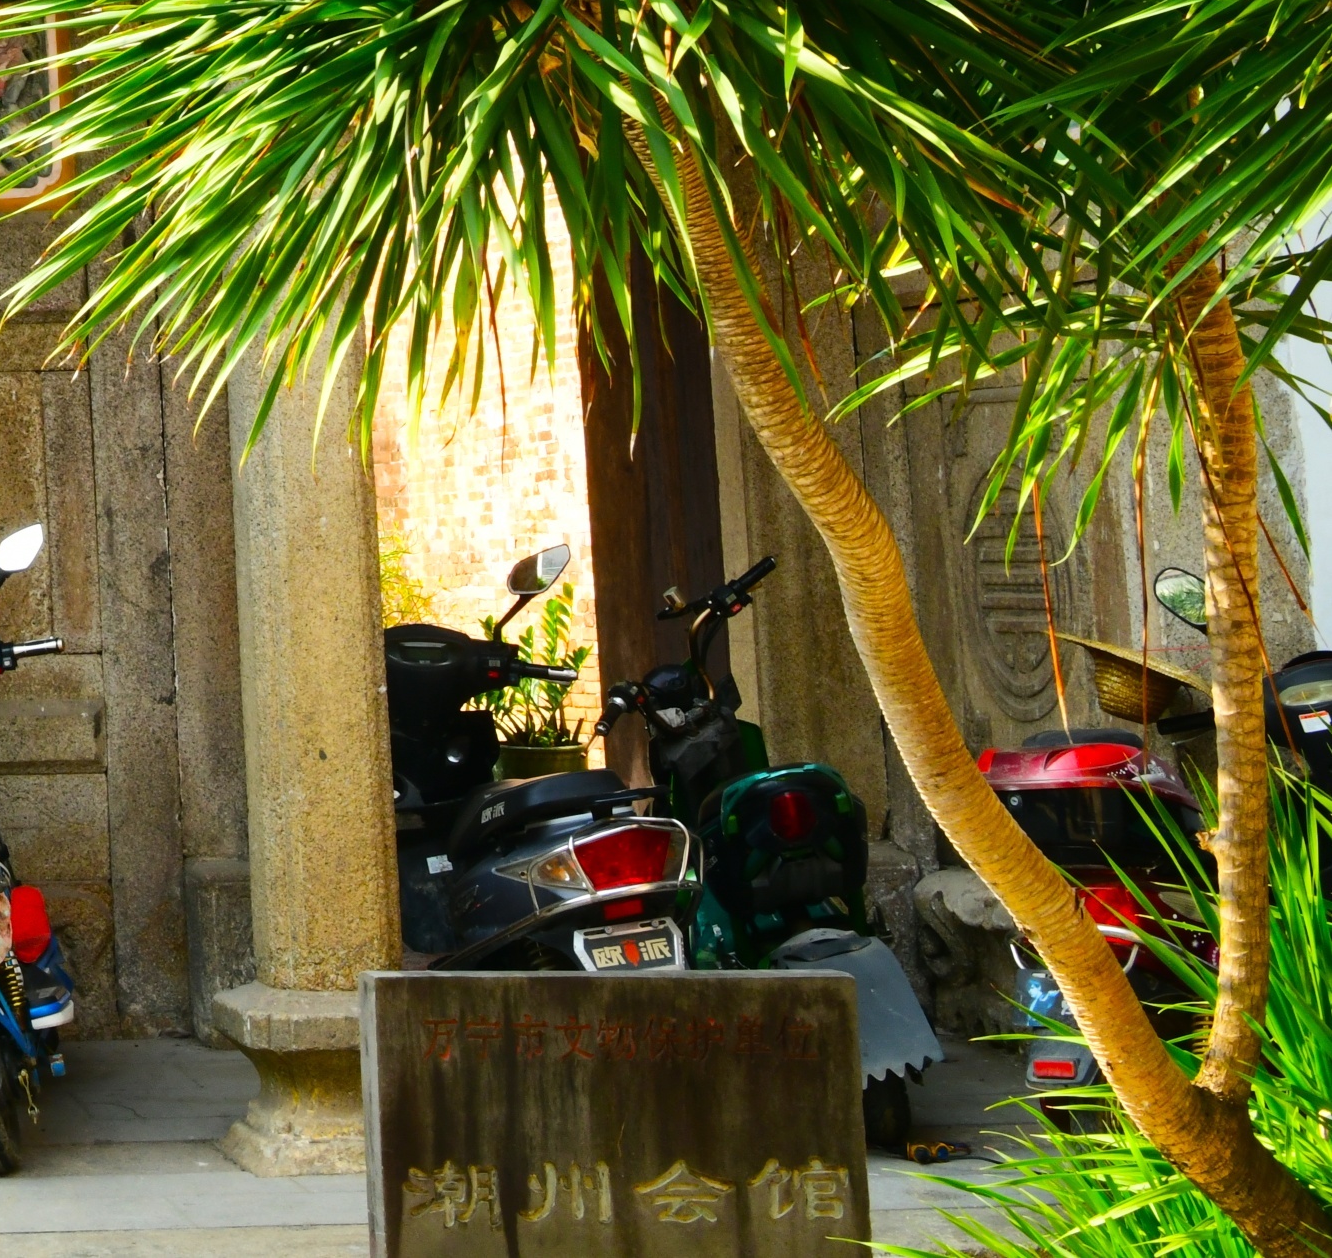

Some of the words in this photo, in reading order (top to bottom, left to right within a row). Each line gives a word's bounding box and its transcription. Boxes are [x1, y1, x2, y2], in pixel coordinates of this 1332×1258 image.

[423, 1014, 820, 1062] 万宁市文物保护单位
[402, 1156, 849, 1228] 潮州会馆
